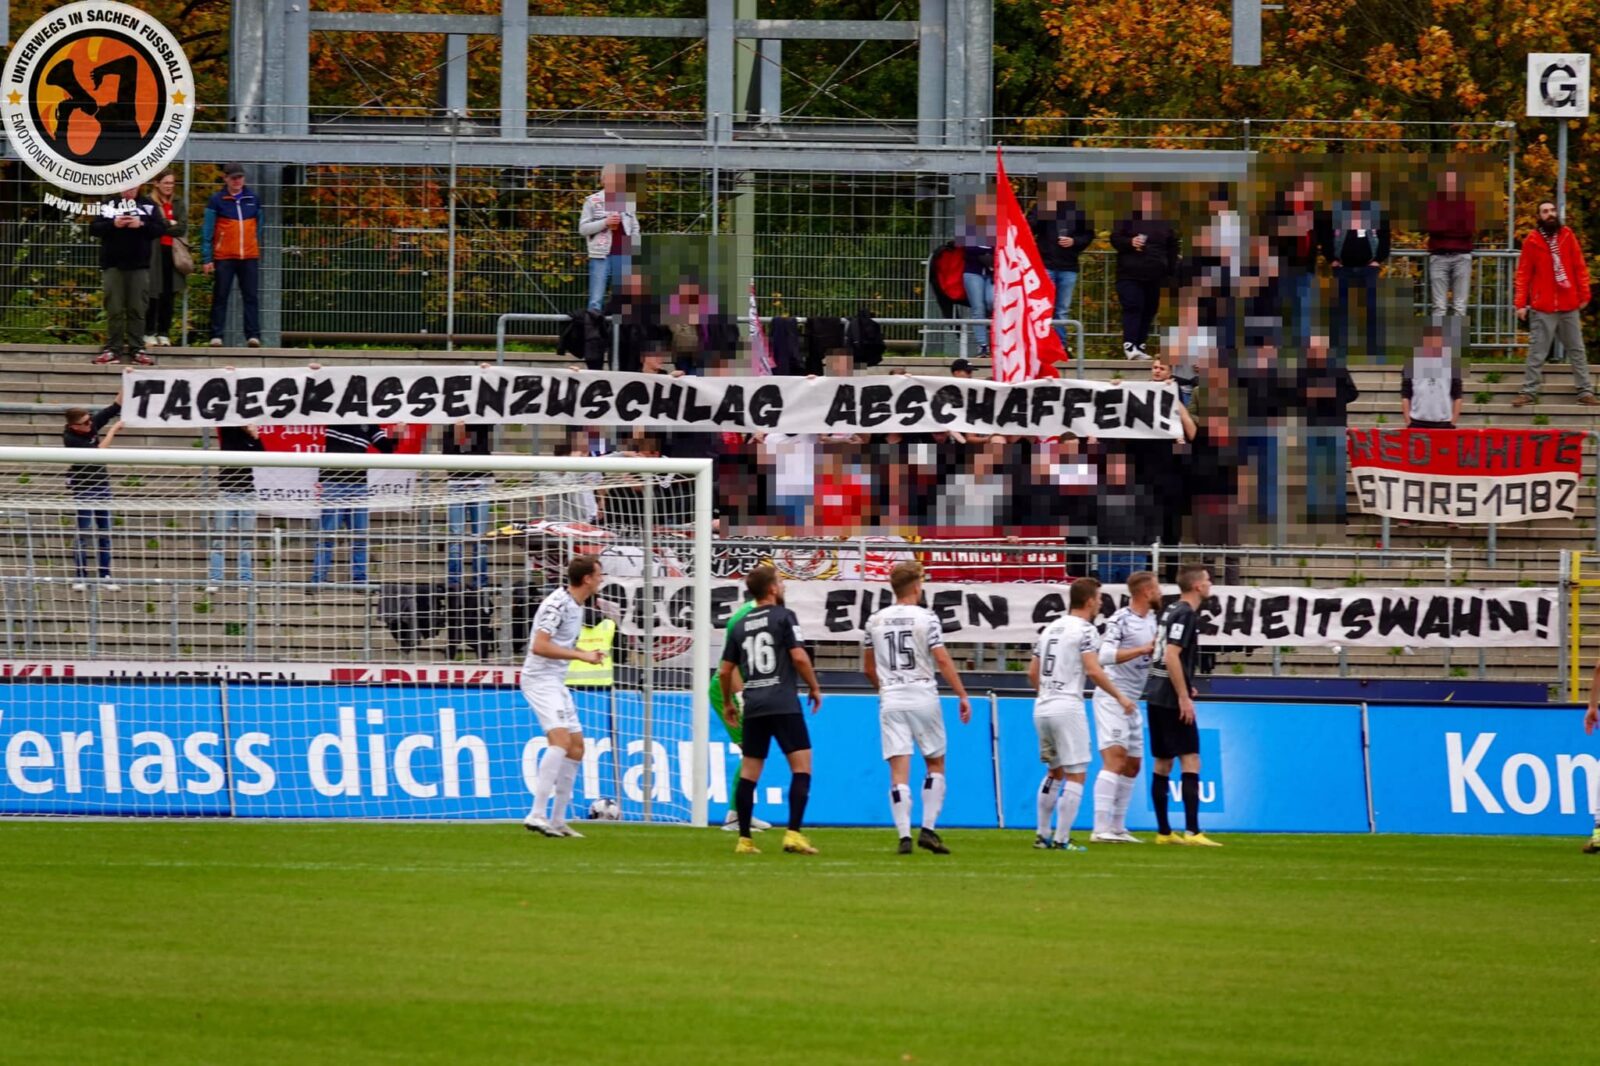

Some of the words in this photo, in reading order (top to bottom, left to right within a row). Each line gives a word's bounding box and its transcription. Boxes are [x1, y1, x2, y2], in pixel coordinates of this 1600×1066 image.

[1540, 63, 1577, 108] G
[132, 375, 784, 427] TAGESKASSENZUSCHLAG
[825, 384, 1175, 431] ABSCHAFFEN!
[742, 631, 777, 676] 16
[884, 630, 916, 671] 15
[1043, 638, 1059, 677] 6
[0, 705, 276, 795] erlass
[308, 706, 491, 798] dich
